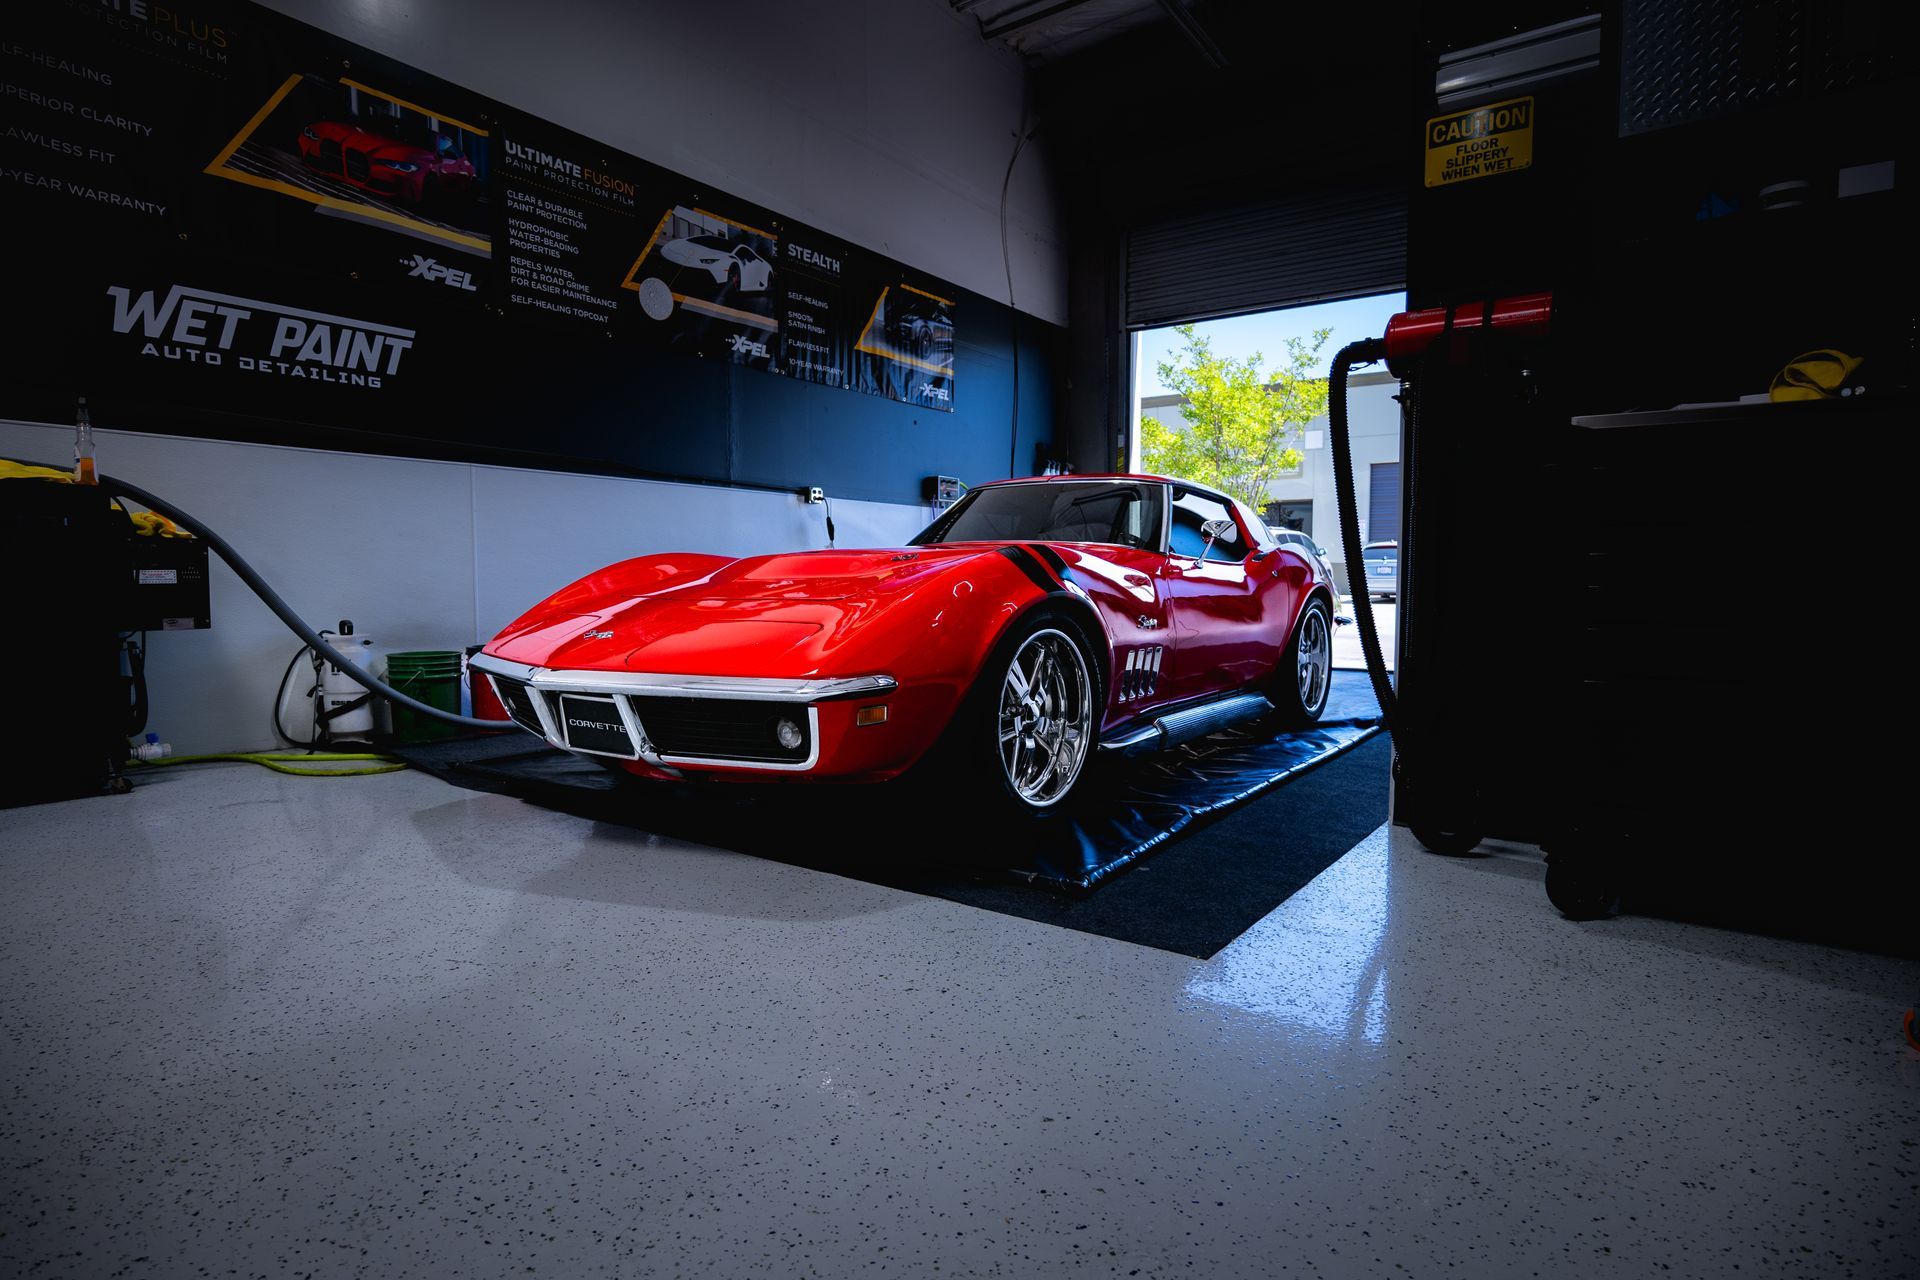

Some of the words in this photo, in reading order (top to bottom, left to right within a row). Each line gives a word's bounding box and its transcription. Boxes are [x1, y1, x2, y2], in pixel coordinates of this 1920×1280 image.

[153, 6, 228, 48] PLUS
[187, 42, 228, 64] FILM
[80, 106, 153, 137] CLARITY
[1432, 106, 1525, 143] CAUTION
[89, 149, 116, 164] FIT
[1446, 147, 1509, 168] SLIPPERY
[1456, 138, 1498, 155] FLOOR
[505, 140, 581, 178] ULTIMATE
[584, 168, 636, 197] FUSION
[1442, 164, 1480, 181] WHEN
[1484, 158, 1514, 172] WET
[505, 156, 538, 173] PAINT
[543, 169, 608, 198] PROTECTION
[613, 193, 635, 207] FILM
[67, 182, 167, 217] WARRANTY
[506, 189, 536, 205] CLEAR
[538, 199, 543, 207] &
[545, 201, 583, 220] DURABLE
[507, 200, 534, 214] PAINT
[536, 208, 587, 230] PROTECTION
[508, 218, 569, 242] HYDROPHOBIC
[509, 228, 579, 255] WATER-BEADING
[510, 238, 560, 258] PROPERTIES
[787, 243, 841, 273] STEALTH
[408, 254, 477, 292] XPEL
[510, 256, 542, 271] REPELS
[544, 265, 575, 280] WATER,
[511, 266, 530, 278] DIRT
[532, 272, 538, 280] &
[540, 274, 564, 286] ROAD
[566, 281, 590, 294] GRIME
[511, 276, 529, 287] FOR
[531, 282, 560, 295] EASIER
[562, 289, 617, 309] MAINTENANCE
[788, 292, 828, 309] SELF-HEALING
[511, 294, 571, 315] SELF-HEALING
[573, 308, 608, 323] TOPCOAT
[788, 311, 813, 323] SMOOTH
[106, 284, 252, 350] WET
[269, 316, 415, 376] PAINT
[788, 320, 807, 330] SATIN
[731, 334, 770, 358] XPEL
[788, 339, 819, 352] FLAWLESS
[140, 342, 222, 366] AUTO
[239, 356, 382, 389] DETAILING
[789, 358, 812, 369] 10-YEAR
[813, 363, 844, 376] WARRANTY
[922, 383, 949, 401] XPEL
[568, 719, 626, 732] CORVETTE
